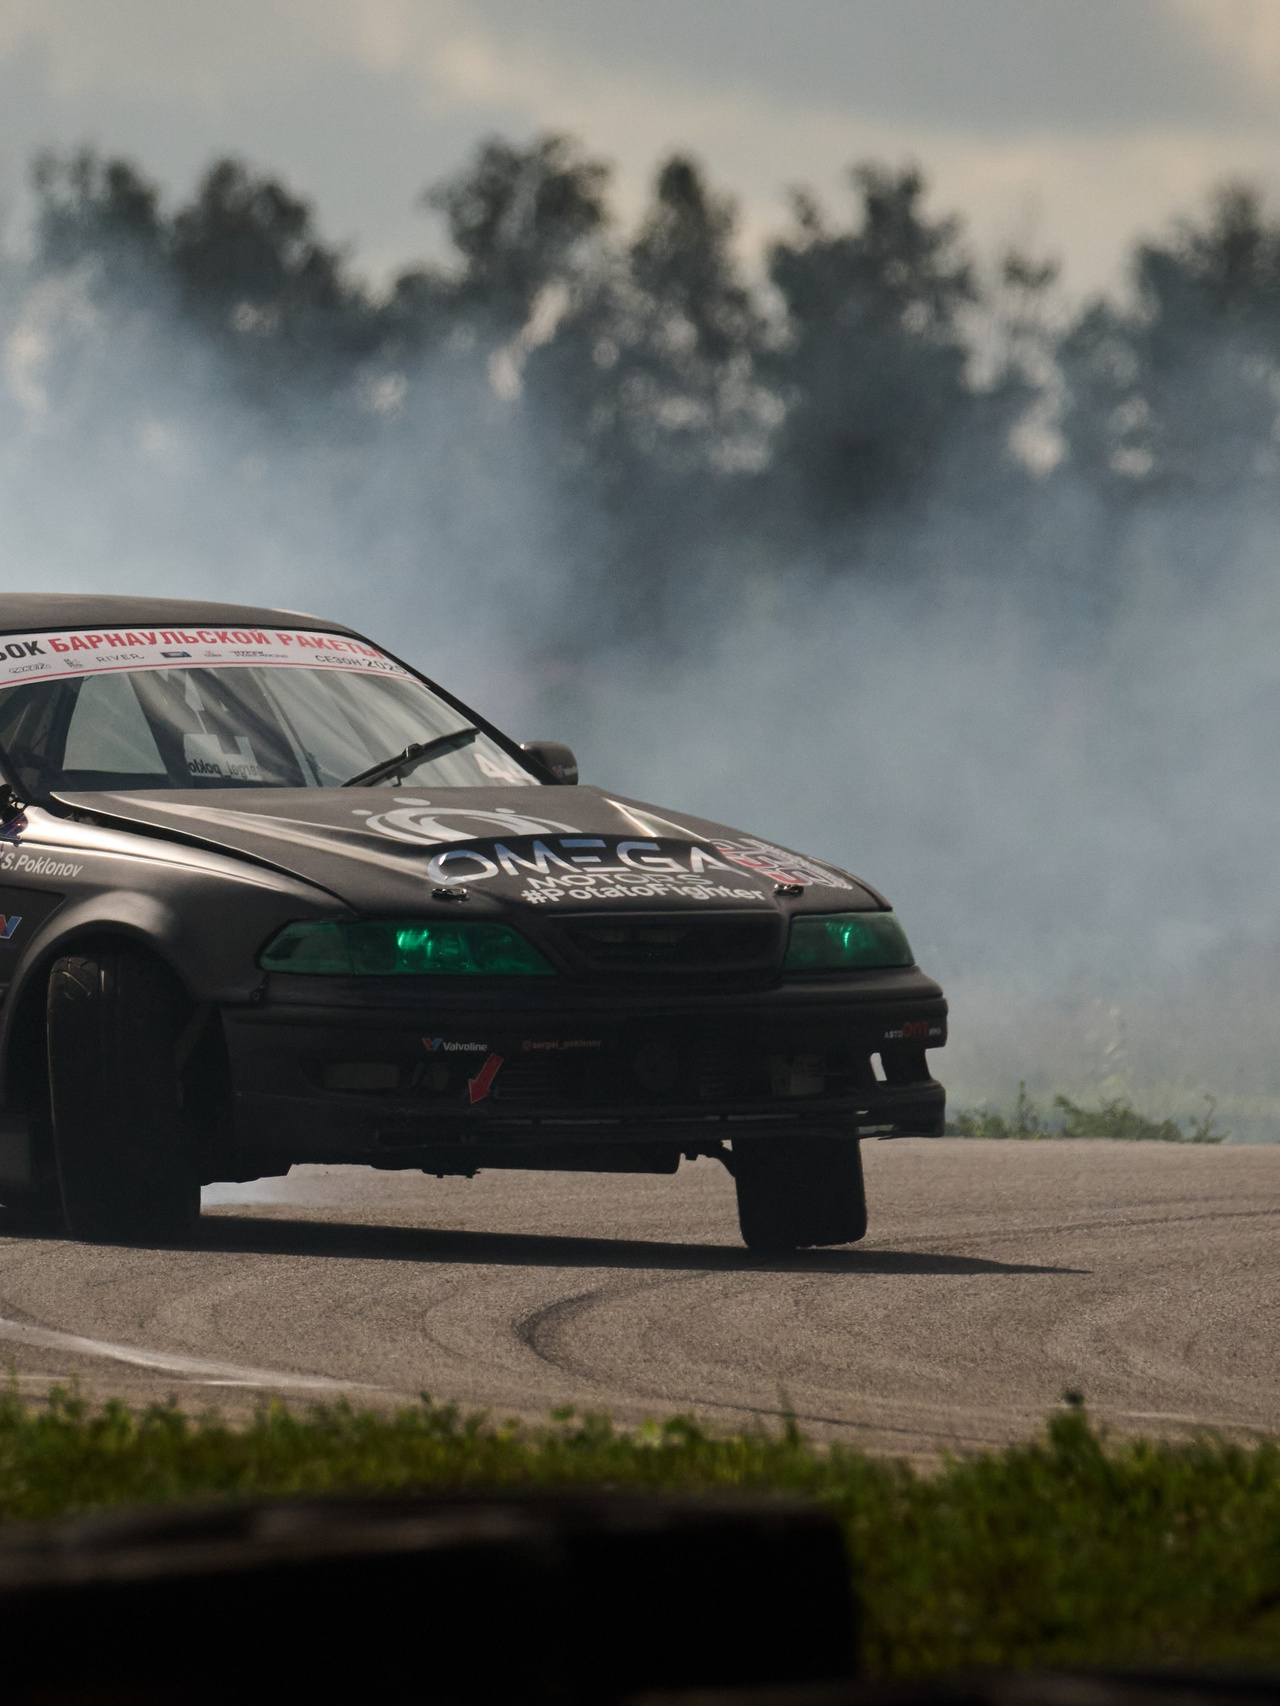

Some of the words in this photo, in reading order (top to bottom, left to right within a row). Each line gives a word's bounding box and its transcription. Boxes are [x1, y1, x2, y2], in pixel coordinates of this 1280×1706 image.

[48, 629, 271, 653] БАРНАУЛЬСКОЙ
[276, 633, 385, 660] РАКЕТЫ
[96, 653, 144, 664] RIVER
[315, 655, 361, 667] СЕЗОН
[1, 852, 83, 878] S.Poklonov
[427, 838, 752, 886] OMEGA
[525, 873, 715, 890] MOTORS
[521, 883, 767, 905] #PotatoFighter
[442, 1041, 488, 1052] Valvoline
